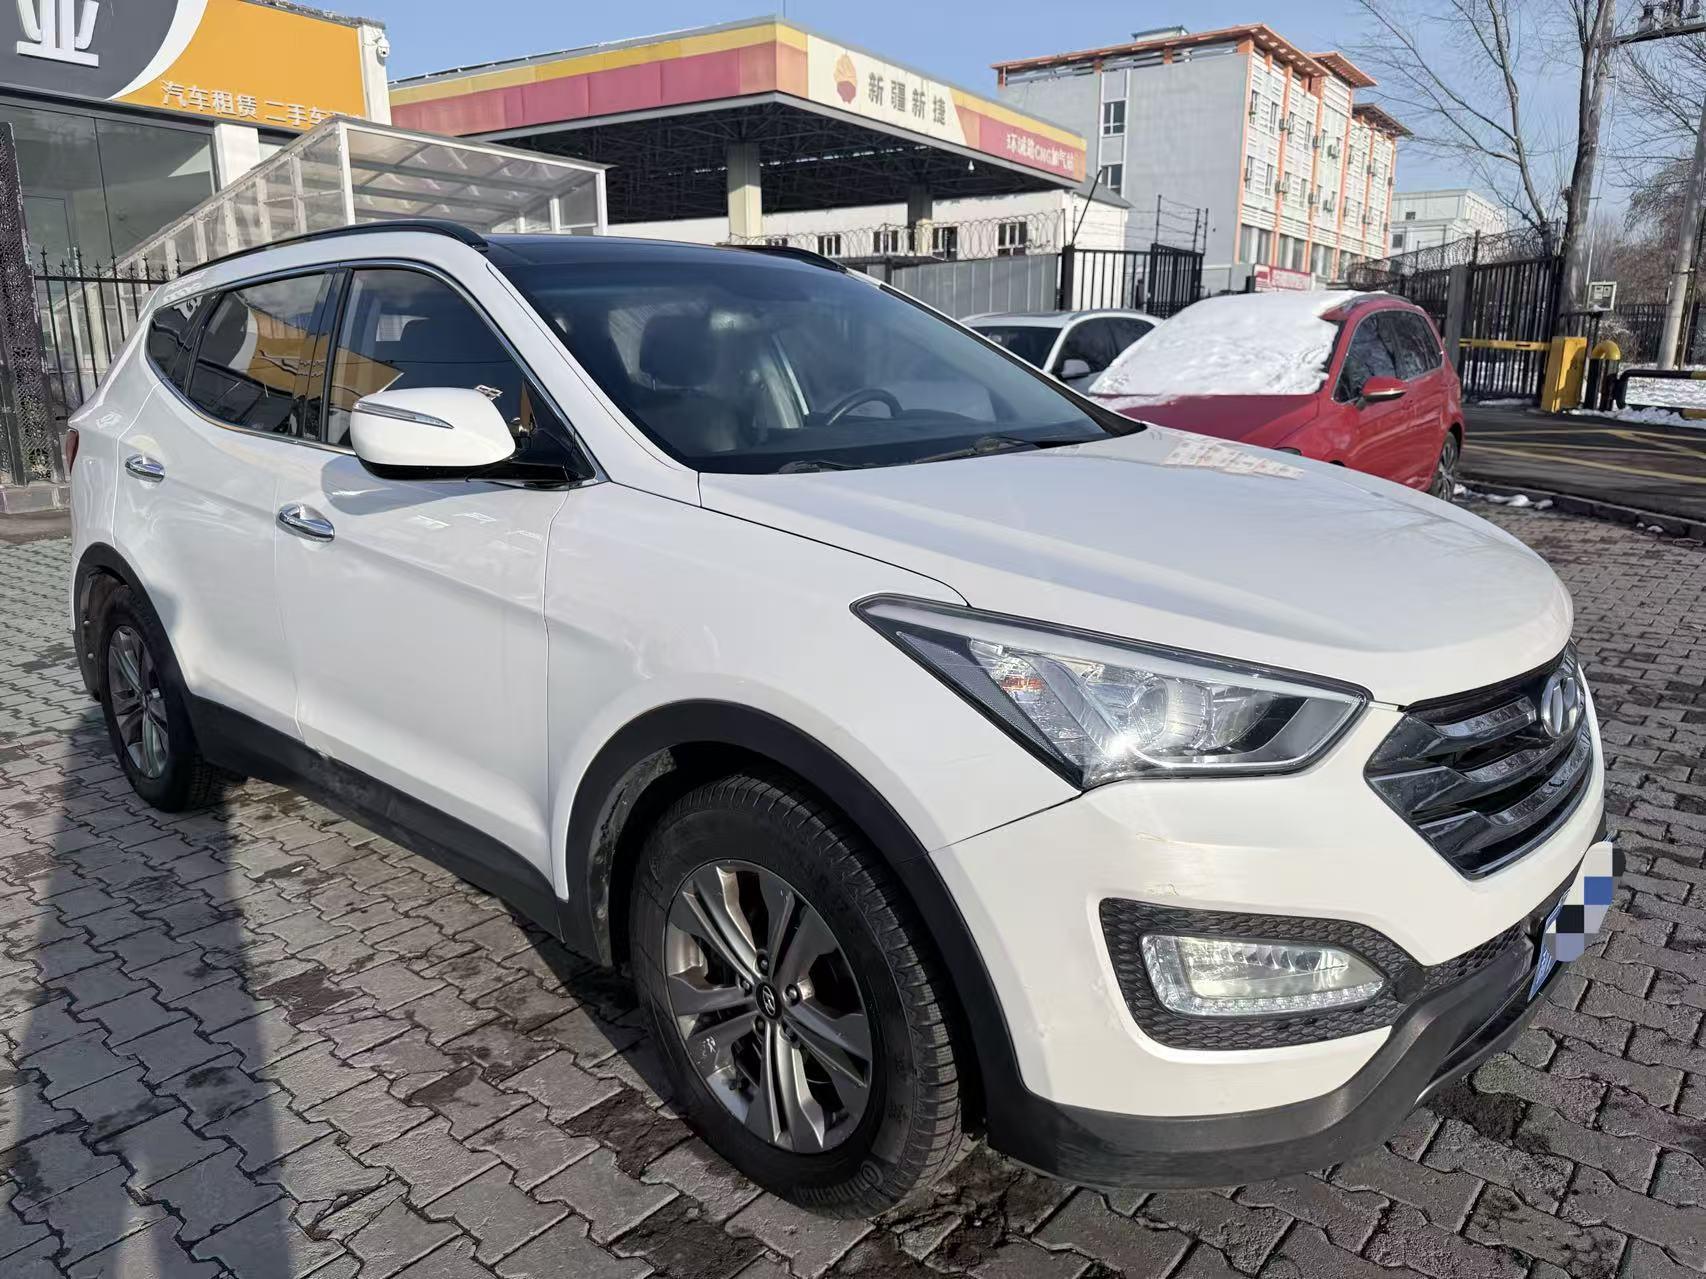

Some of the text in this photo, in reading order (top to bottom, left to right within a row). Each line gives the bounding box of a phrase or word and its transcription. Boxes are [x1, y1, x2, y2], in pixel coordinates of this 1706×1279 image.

[160, 80, 361, 127] 汽车租赁 二手车
[868, 72, 946, 126] 新疆新捷
